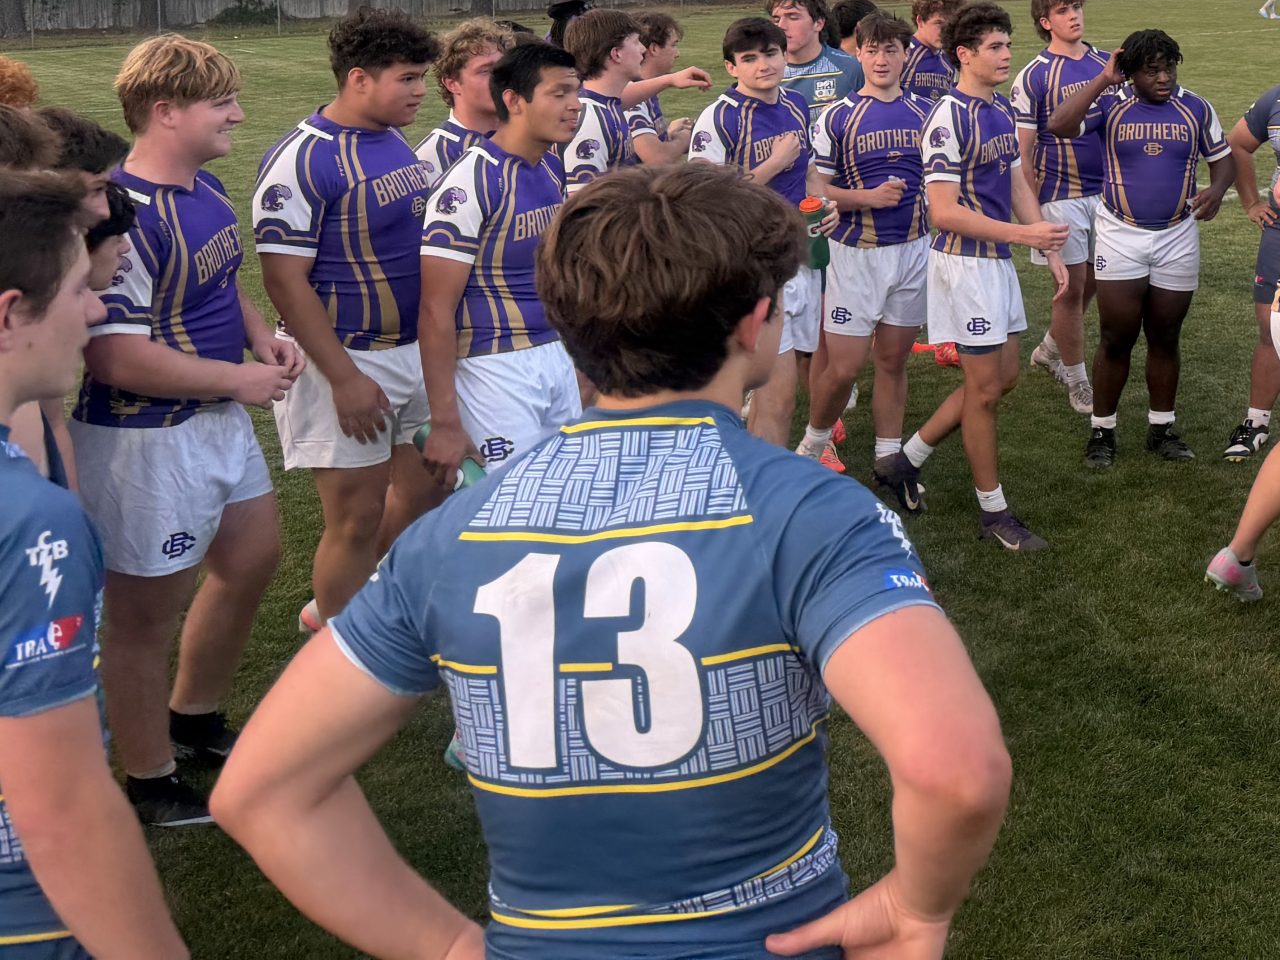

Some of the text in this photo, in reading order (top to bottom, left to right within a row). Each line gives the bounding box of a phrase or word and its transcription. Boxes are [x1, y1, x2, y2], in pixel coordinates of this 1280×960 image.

[856, 129, 920, 155] BROTHER
[1118, 123, 1188, 142] BROTHERS
[980, 133, 1015, 165] BROTHER
[193, 222, 241, 285] BROTHER
[473, 541, 704, 768] 13
